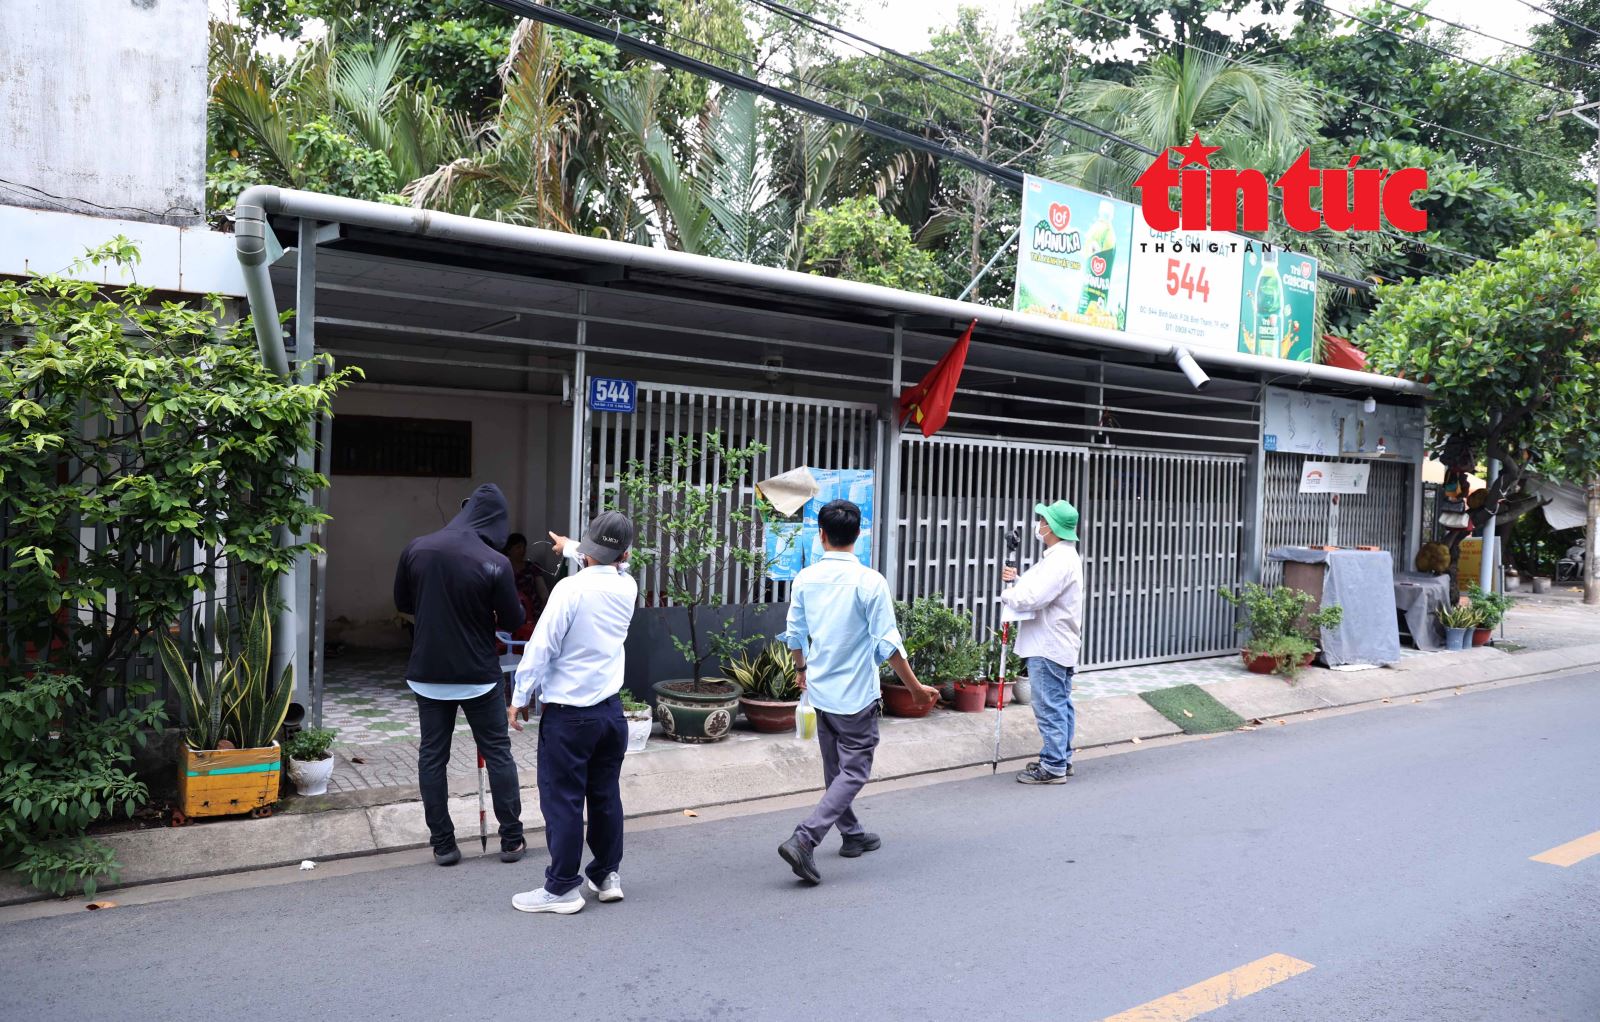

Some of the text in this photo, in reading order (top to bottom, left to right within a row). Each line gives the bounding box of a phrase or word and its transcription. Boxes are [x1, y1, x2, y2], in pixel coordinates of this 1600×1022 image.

[1033, 224, 1081, 254] MANUKA
[1166, 257, 1210, 303] 544
[596, 379, 630, 403] 544
